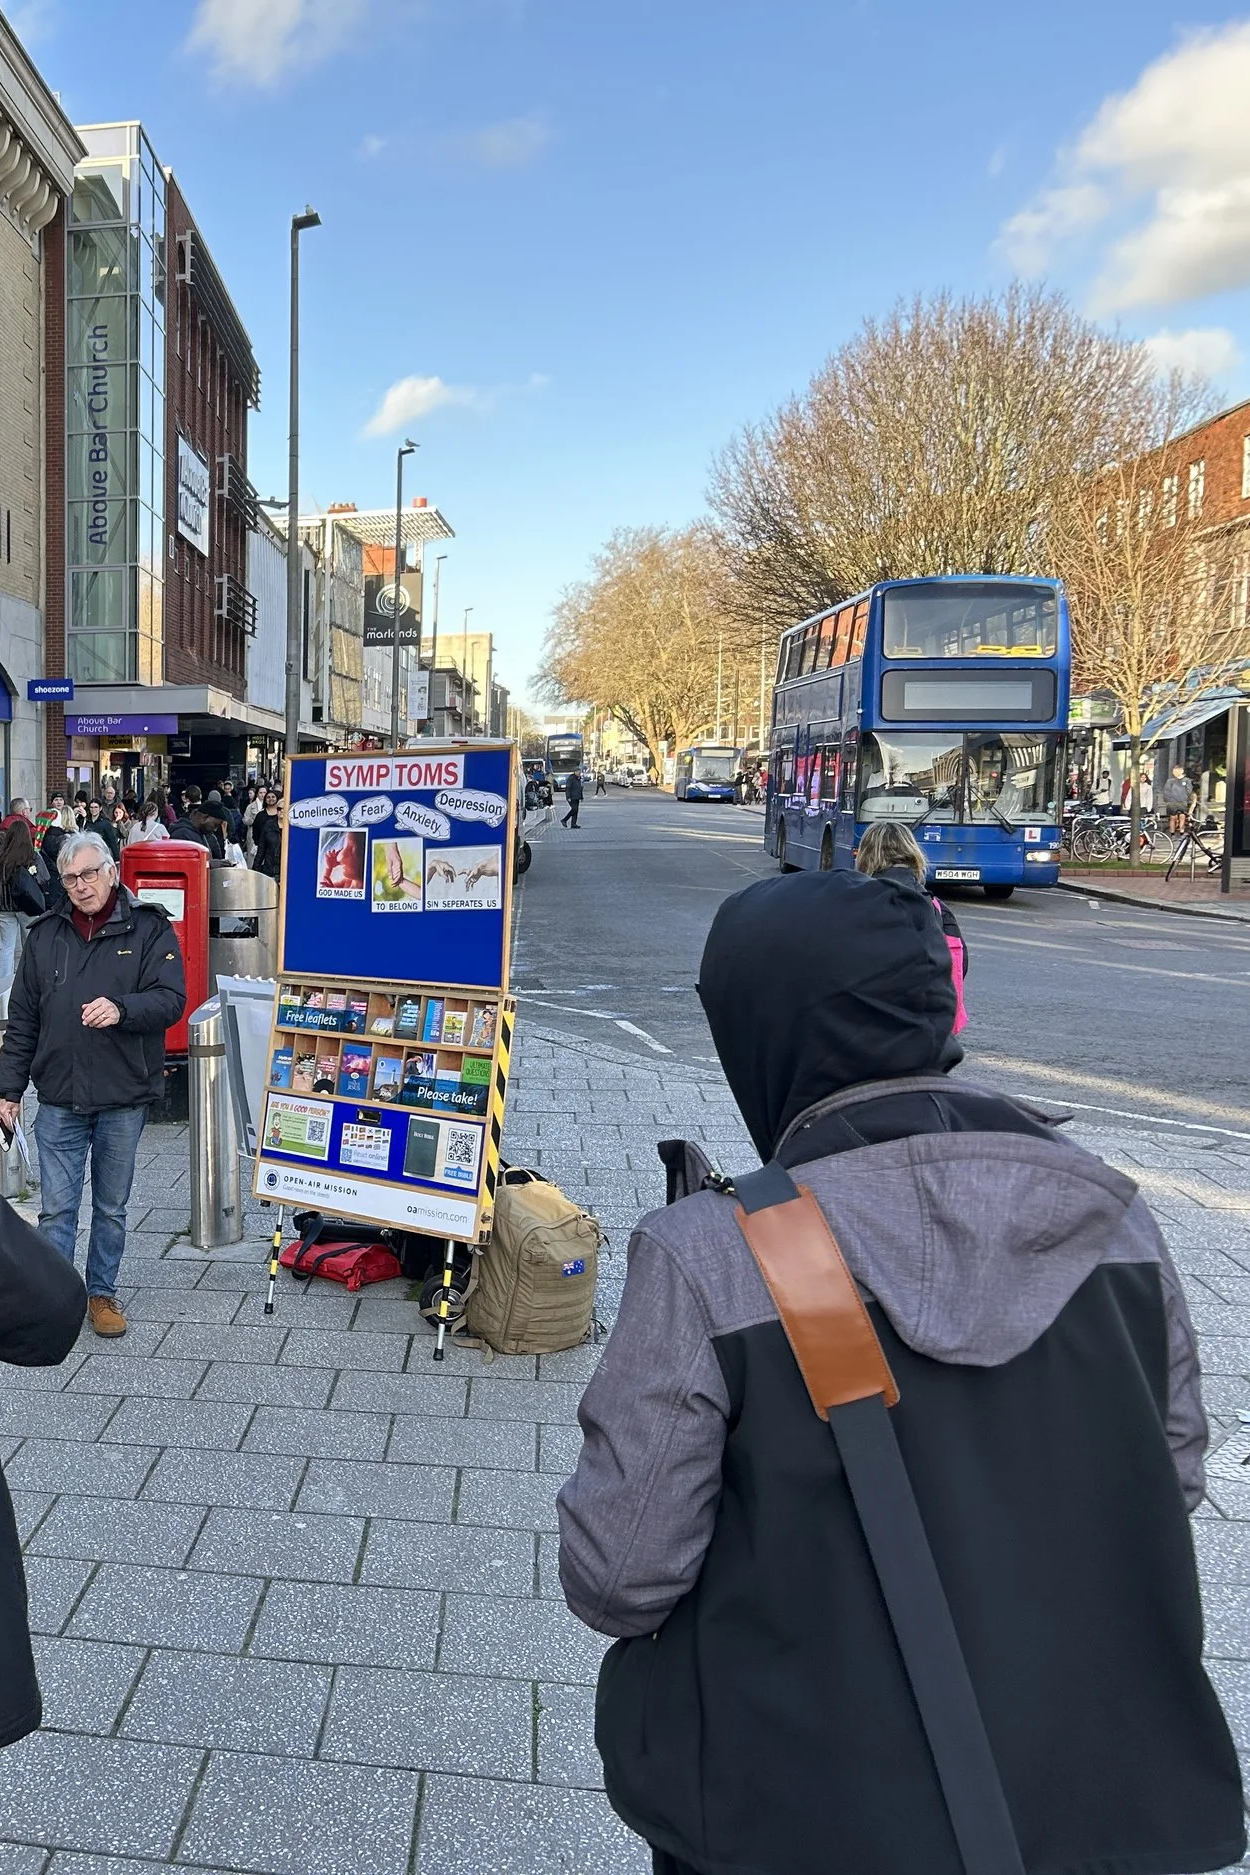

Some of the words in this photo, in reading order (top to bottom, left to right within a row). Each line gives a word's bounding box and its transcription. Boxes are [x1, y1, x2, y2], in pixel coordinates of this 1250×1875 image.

[88, 323, 108, 413] Church
[89, 422, 108, 463] Bar
[88, 470, 108, 546] Above
[34, 685, 70, 695] shoezone
[77, 717, 105, 726] Above
[107, 717, 122, 726] Bar
[77, 724, 109, 734] Church
[328, 762, 459, 788] SYMPTOMS
[292, 804, 345, 820] Loneliness
[361, 803, 385, 817] Fear
[439, 792, 504, 817] Depression
[402, 805, 442, 835] Anxiety
[1028, 829, 1038, 840] L
[937, 870, 960, 879] W504
[961, 870, 980, 879] WGH
[318, 889, 332, 897] GOD
[333, 890, 352, 898] MADE
[376, 902, 386, 911] TO
[389, 902, 418, 911] BELONG
[426, 901, 439, 909] SIN
[442, 900, 484, 909] SEPERATES
[487, 900, 497, 908] US
[286, 1011, 305, 1023] Free
[305, 1012, 338, 1026] leaflets
[417, 1087, 450, 1102] Please
[452, 1092, 478, 1106] take!
[444, 1168, 458, 1177] FREE
[458, 1170, 473, 1180] BIBLE
[284, 1175, 321, 1189] OPEN-AIR
[324, 1184, 358, 1196] MISSION
[406, 1204, 468, 1225] oamission.com
